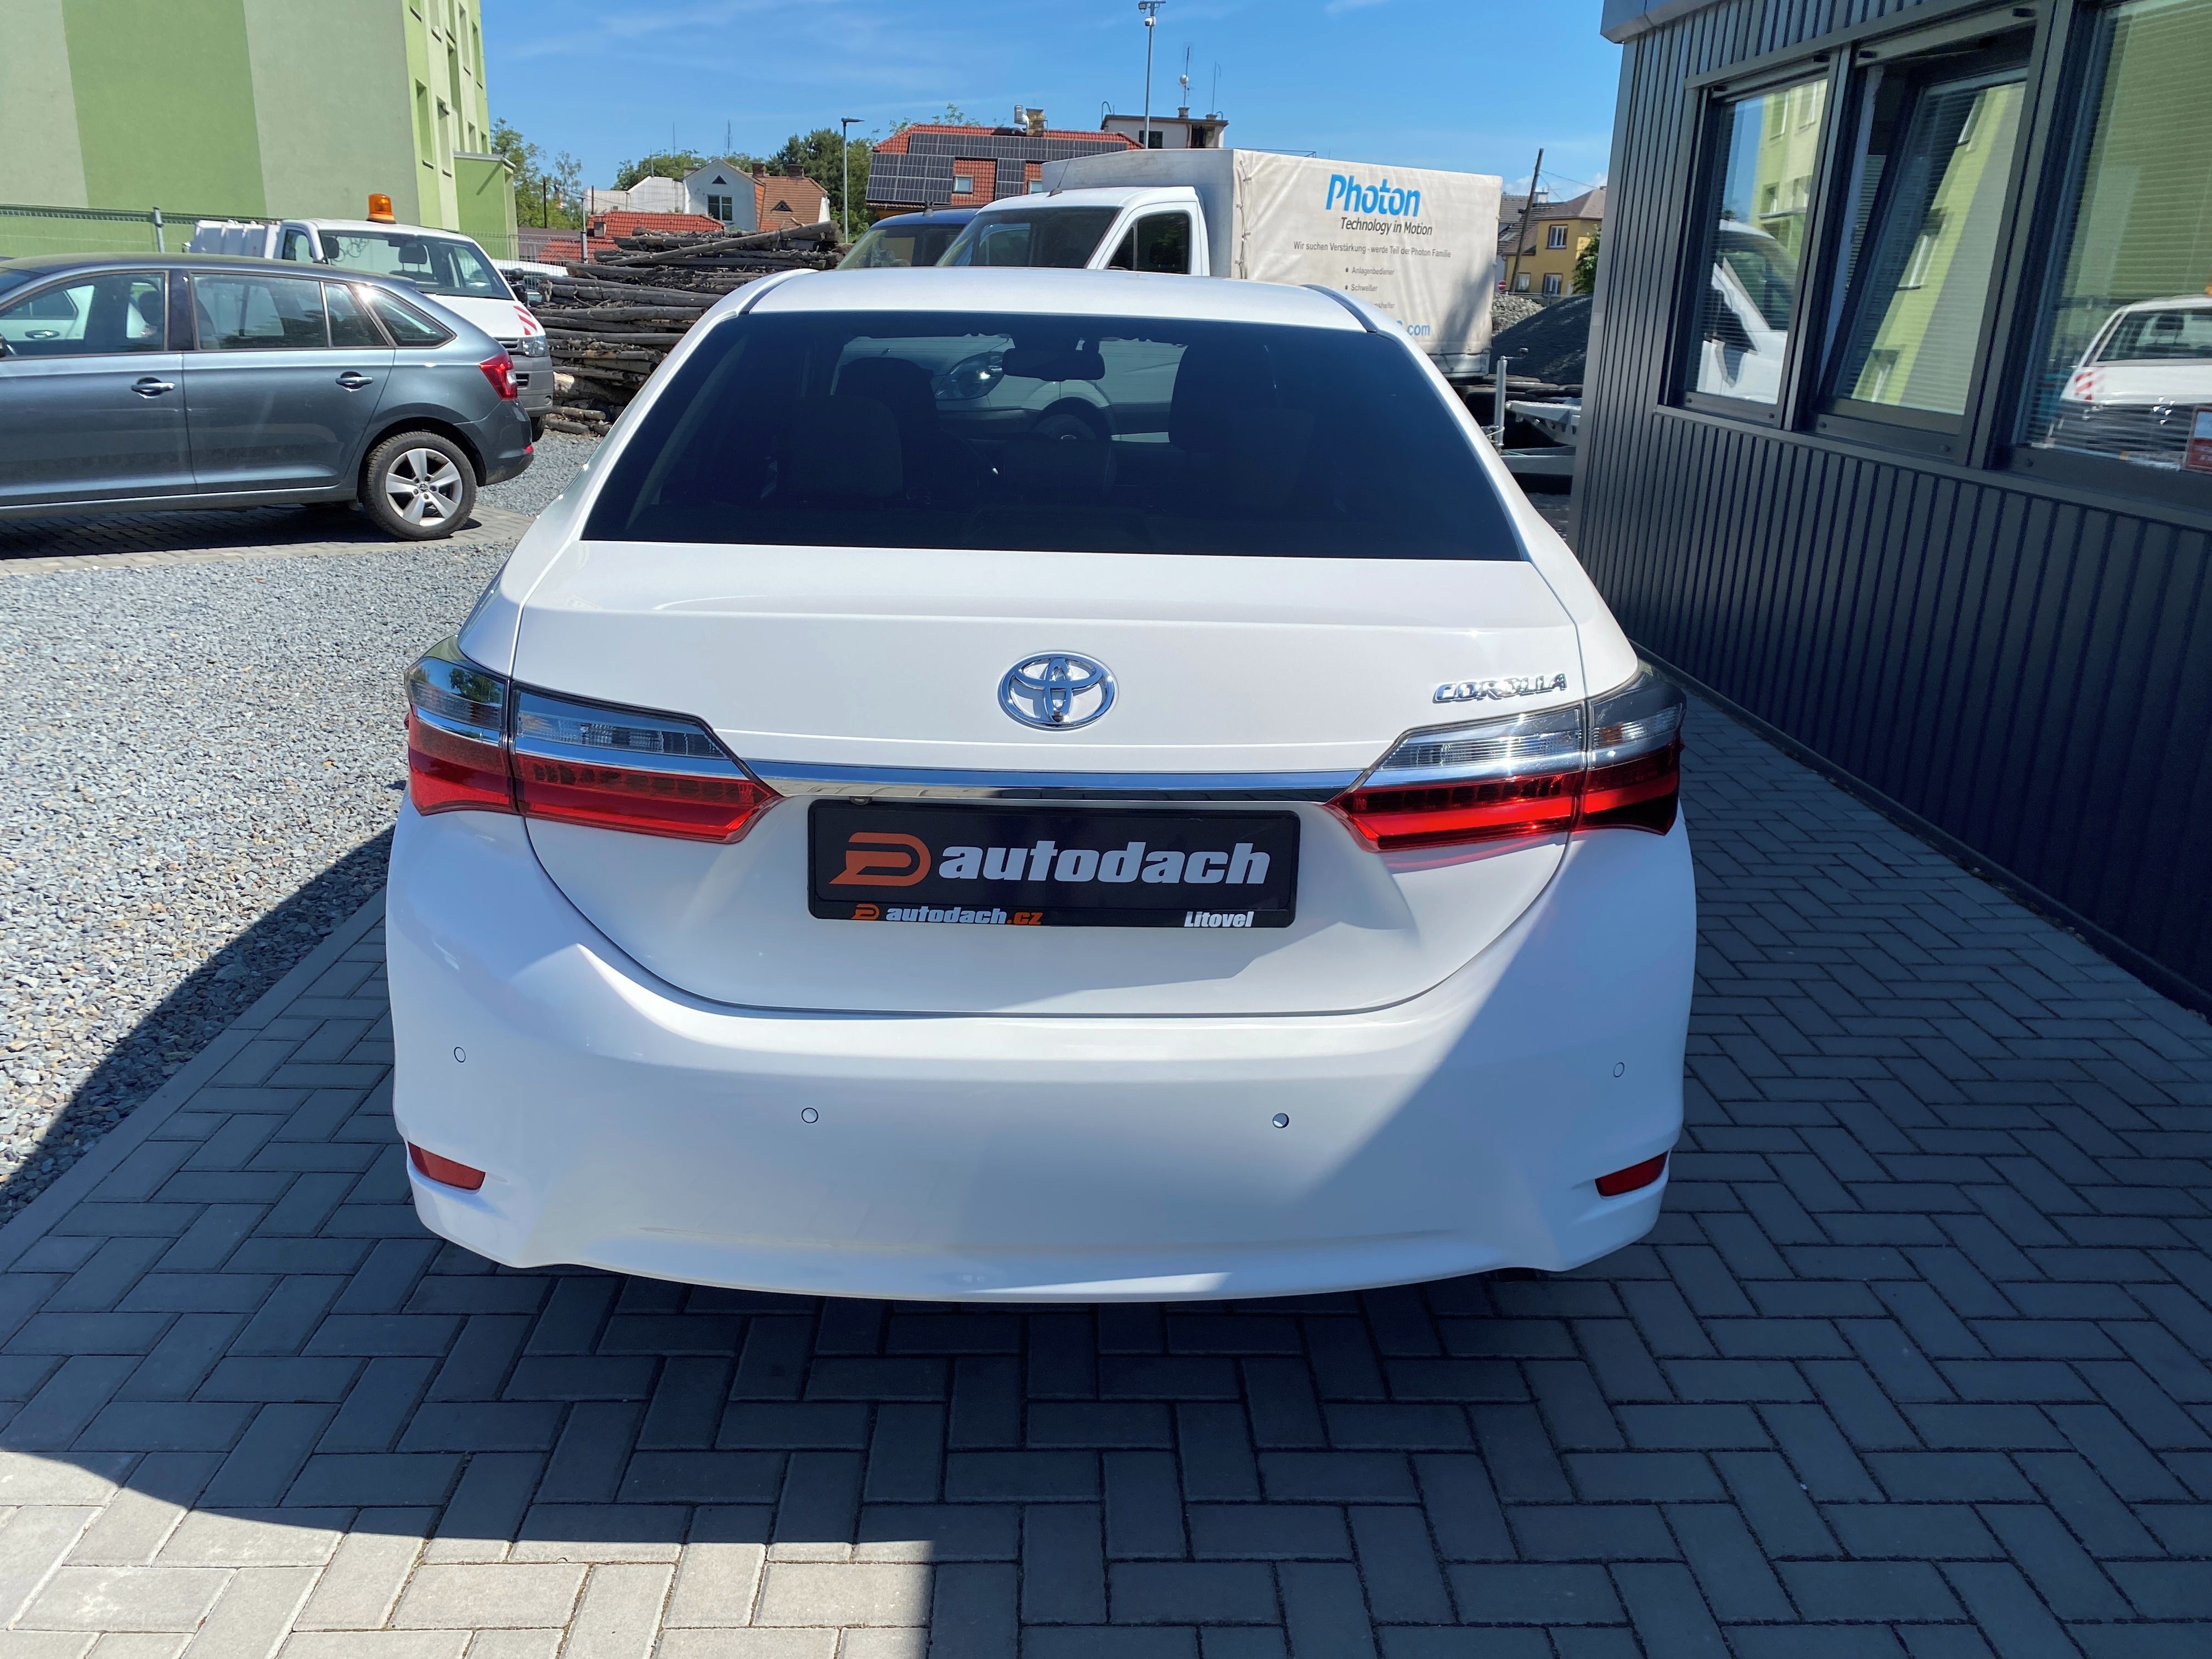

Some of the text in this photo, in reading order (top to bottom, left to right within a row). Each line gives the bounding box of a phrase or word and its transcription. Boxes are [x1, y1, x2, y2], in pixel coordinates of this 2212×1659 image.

[1325, 173, 1421, 217] Photon
[1341, 217, 1432, 236] Technology in Motion
[1294, 241, 1305, 250] Wir
[1306, 242, 1328, 251] suchen
[1330, 242, 1366, 255] Verstärkung
[1370, 245, 1389, 253] werde
[1390, 245, 1400, 254] Teil
[1401, 246, 1410, 255] der
[1411, 247, 1431, 256] Photon
[1432, 249, 1451, 258] Familie
[1351, 266, 1395, 275] Anlagenbediener
[1432, 672, 1567, 703] COROLLA
[939, 840, 1271, 884] autodach
[886, 906, 1043, 926] autodach.cz
[1184, 911, 1255, 927] Litovel
